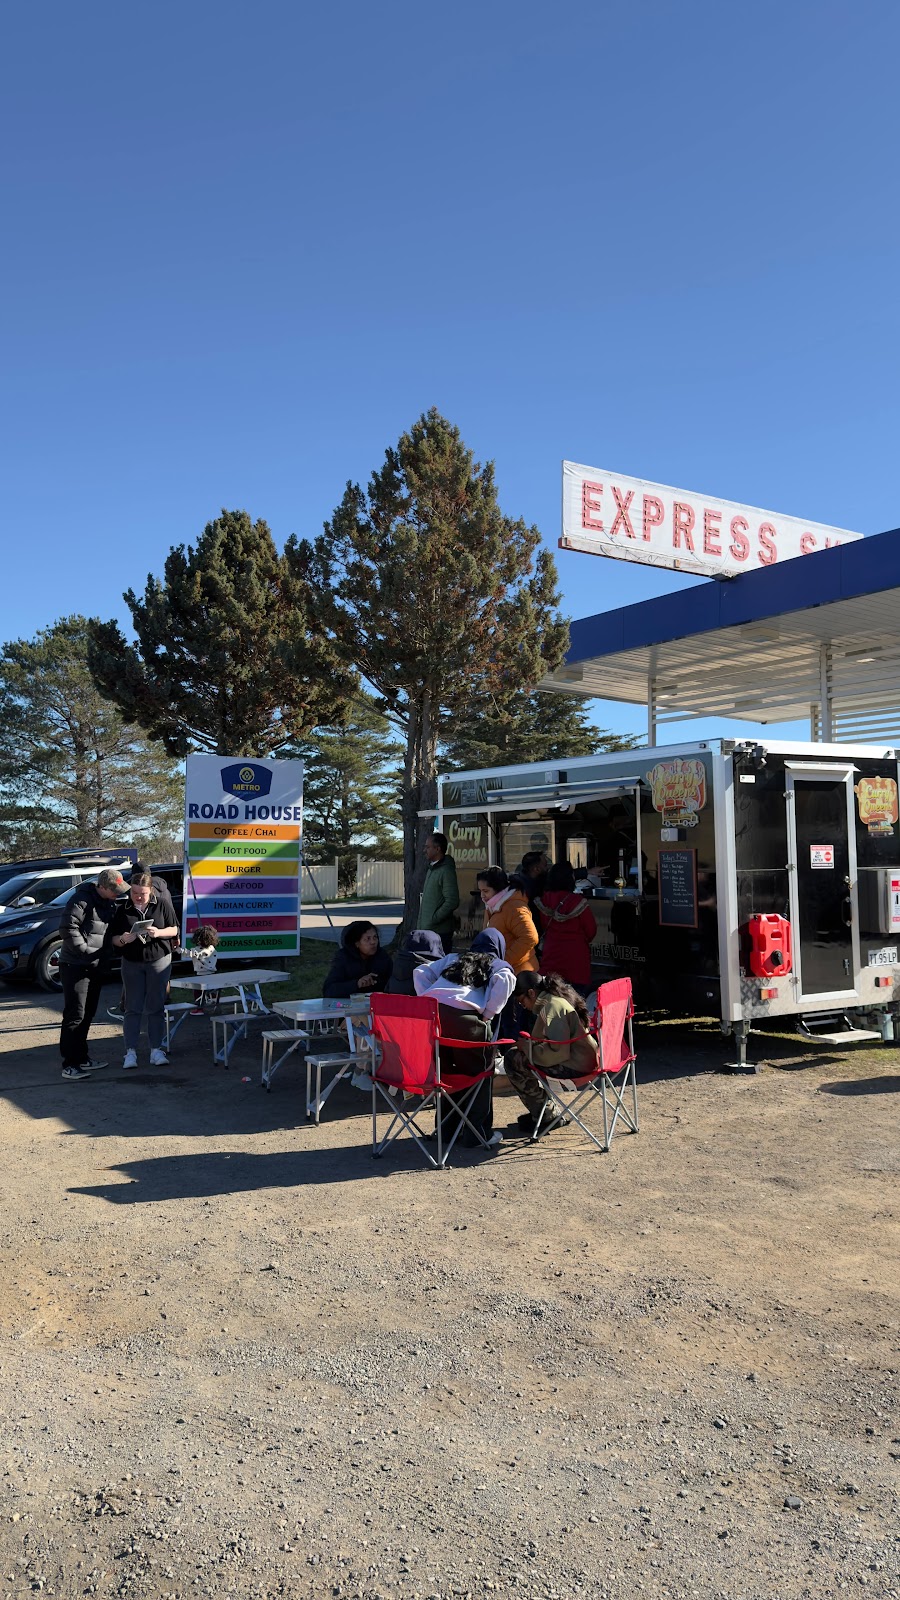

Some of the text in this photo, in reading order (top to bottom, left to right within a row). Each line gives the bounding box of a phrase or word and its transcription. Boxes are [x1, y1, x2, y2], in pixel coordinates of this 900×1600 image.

[581, 479, 778, 566] EXPRESS
[232, 783, 261, 791] METRO
[662, 770, 694, 787] Curry
[660, 786, 697, 801] Queens
[866, 785, 890, 802] Curry
[188, 803, 301, 821] ROAD HOUSE
[449, 820, 482, 847] Curry
[243, 847, 267, 855] FOOD
[216, 938, 283, 947] TORPASS CARDS
